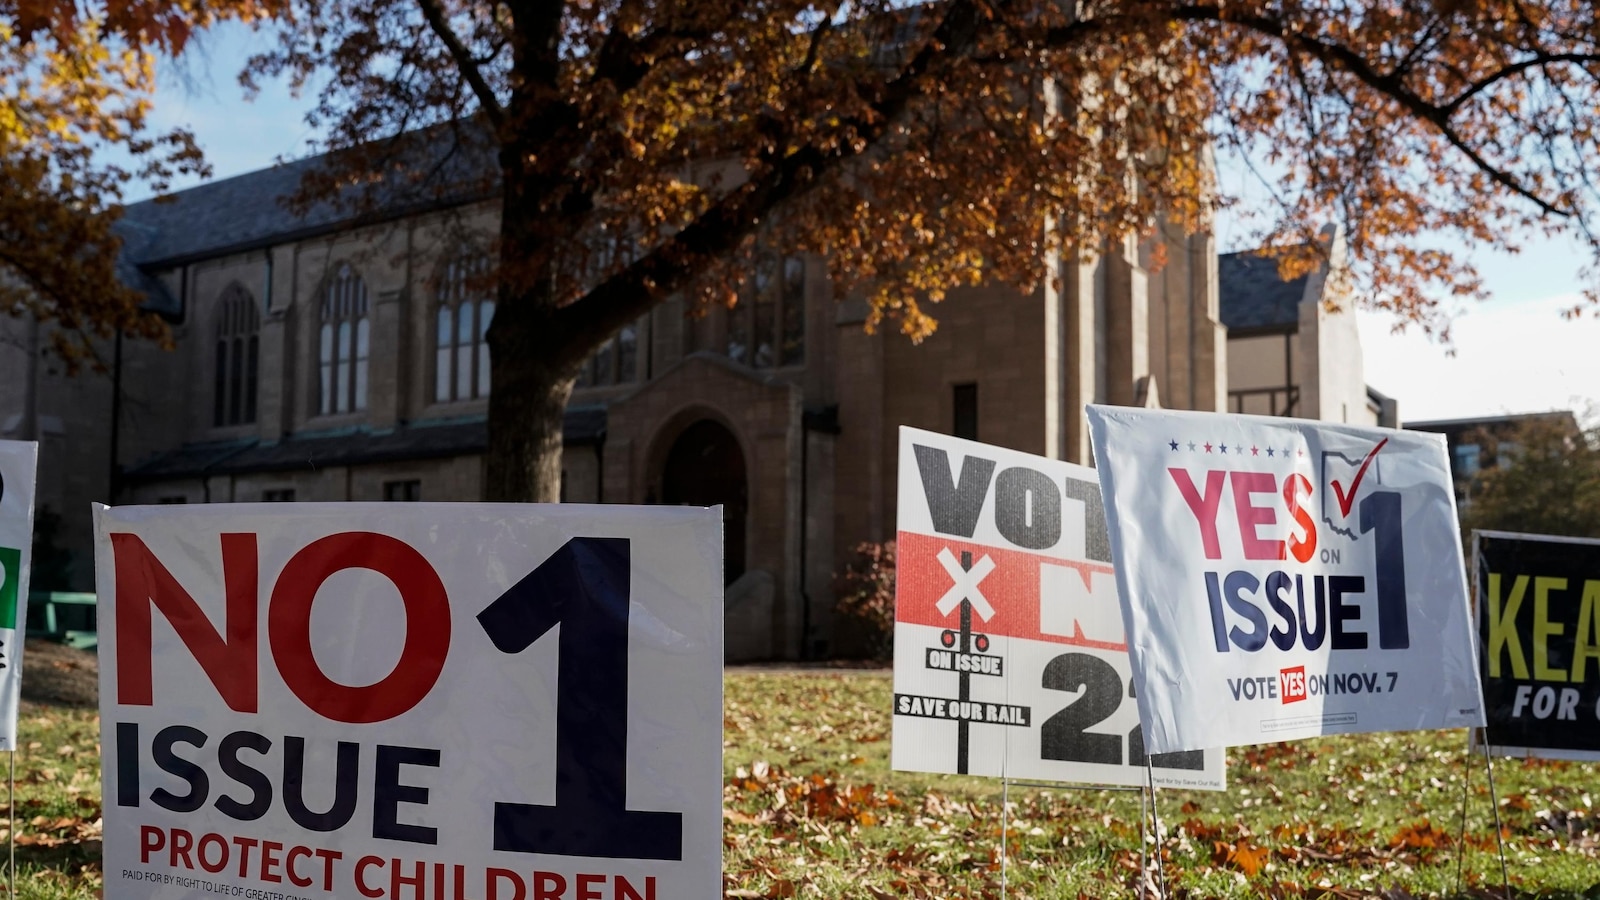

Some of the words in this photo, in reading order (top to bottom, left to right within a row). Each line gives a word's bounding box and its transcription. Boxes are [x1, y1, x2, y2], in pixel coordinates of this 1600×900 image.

[1167, 468, 1317, 563] YES
[1320, 548, 1341, 564] ON
[1359, 491, 1410, 650] 1
[110, 531, 452, 724] NO
[1204, 570, 1368, 652] ISSUE
[476, 536, 684, 861] 1
[929, 650, 952, 670] ON
[955, 653, 1001, 675] ISSUE
[1227, 676, 1277, 701] VOTE
[1280, 671, 1305, 697] YES
[1309, 674, 1329, 696] ON
[1333, 672, 1381, 694] NOV.
[1386, 672, 1398, 692] 7
[899, 696, 946, 717] SAVE
[948, 701, 983, 721] OUR
[986, 705, 1026, 725] RAIL
[1512, 685, 1580, 721] FOR
[116, 722, 441, 846] ISSUE
[122, 869, 143, 881] PAID
[145, 872, 162, 883] FOR
[164, 874, 175, 885] BY
[176, 876, 200, 889] RIGHT
[201, 880, 213, 892] TO
[214, 883, 230, 895] LIFE
[231, 886, 243, 897] OF
[140, 825, 343, 892] PROTECT
[354, 855, 656, 900] CHILDREN
